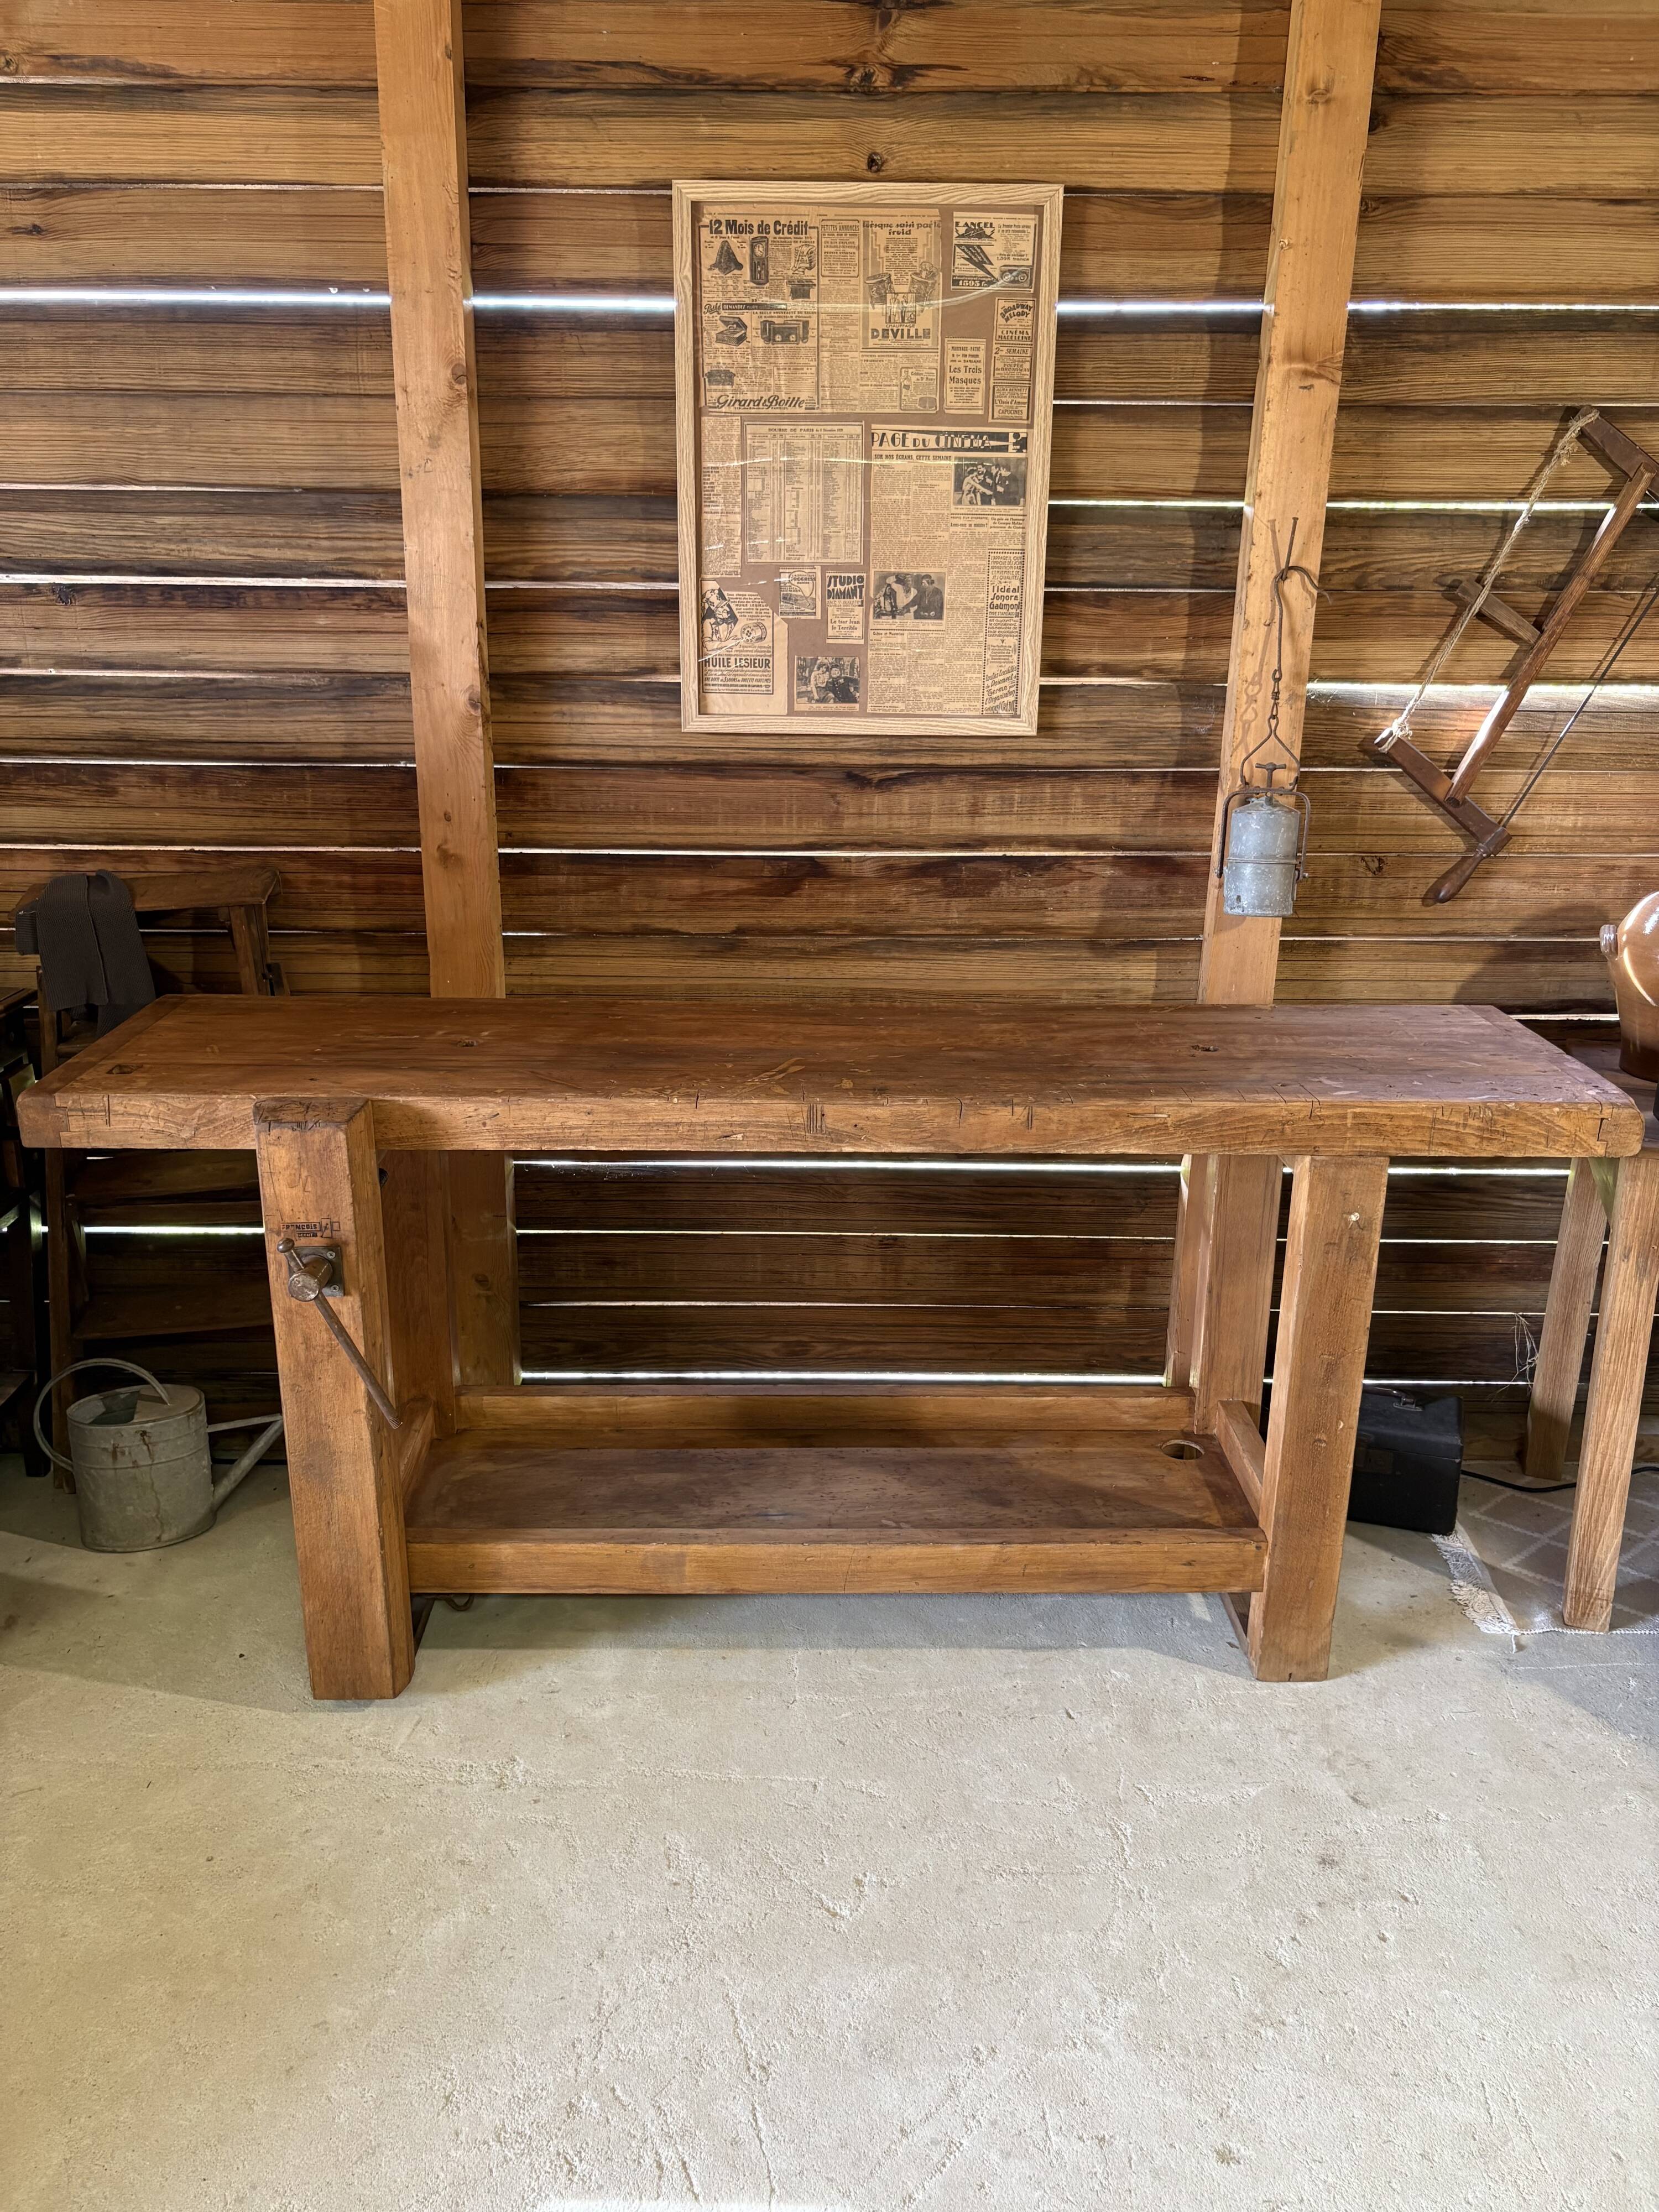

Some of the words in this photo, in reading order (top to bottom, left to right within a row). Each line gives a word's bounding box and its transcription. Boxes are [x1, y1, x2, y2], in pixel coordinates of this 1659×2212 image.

[709, 219, 723, 234] 12
[725, 220, 754, 234] Mois
[757, 220, 770, 234] de
[774, 220, 808, 235] Crédit
[1000, 303, 1033, 319] BROADWAY
[1004, 310, 1030, 323] MELODY
[870, 328, 931, 339] DEVILLE
[949, 366, 962, 374] Les
[963, 366, 982, 374] Trois
[949, 376, 982, 386] Masques
[717, 395, 764, 409] Girard
[872, 432, 910, 447] PAGE
[912, 438, 930, 447] DU
[827, 575, 864, 588] STUDIO
[827, 585, 864, 599] DIAMANT
[990, 593, 1019, 602] Sonore
[989, 601, 1020, 611] Gaumont
[705, 658, 731, 667] HUILE
[734, 658, 771, 669] LESIEUR
